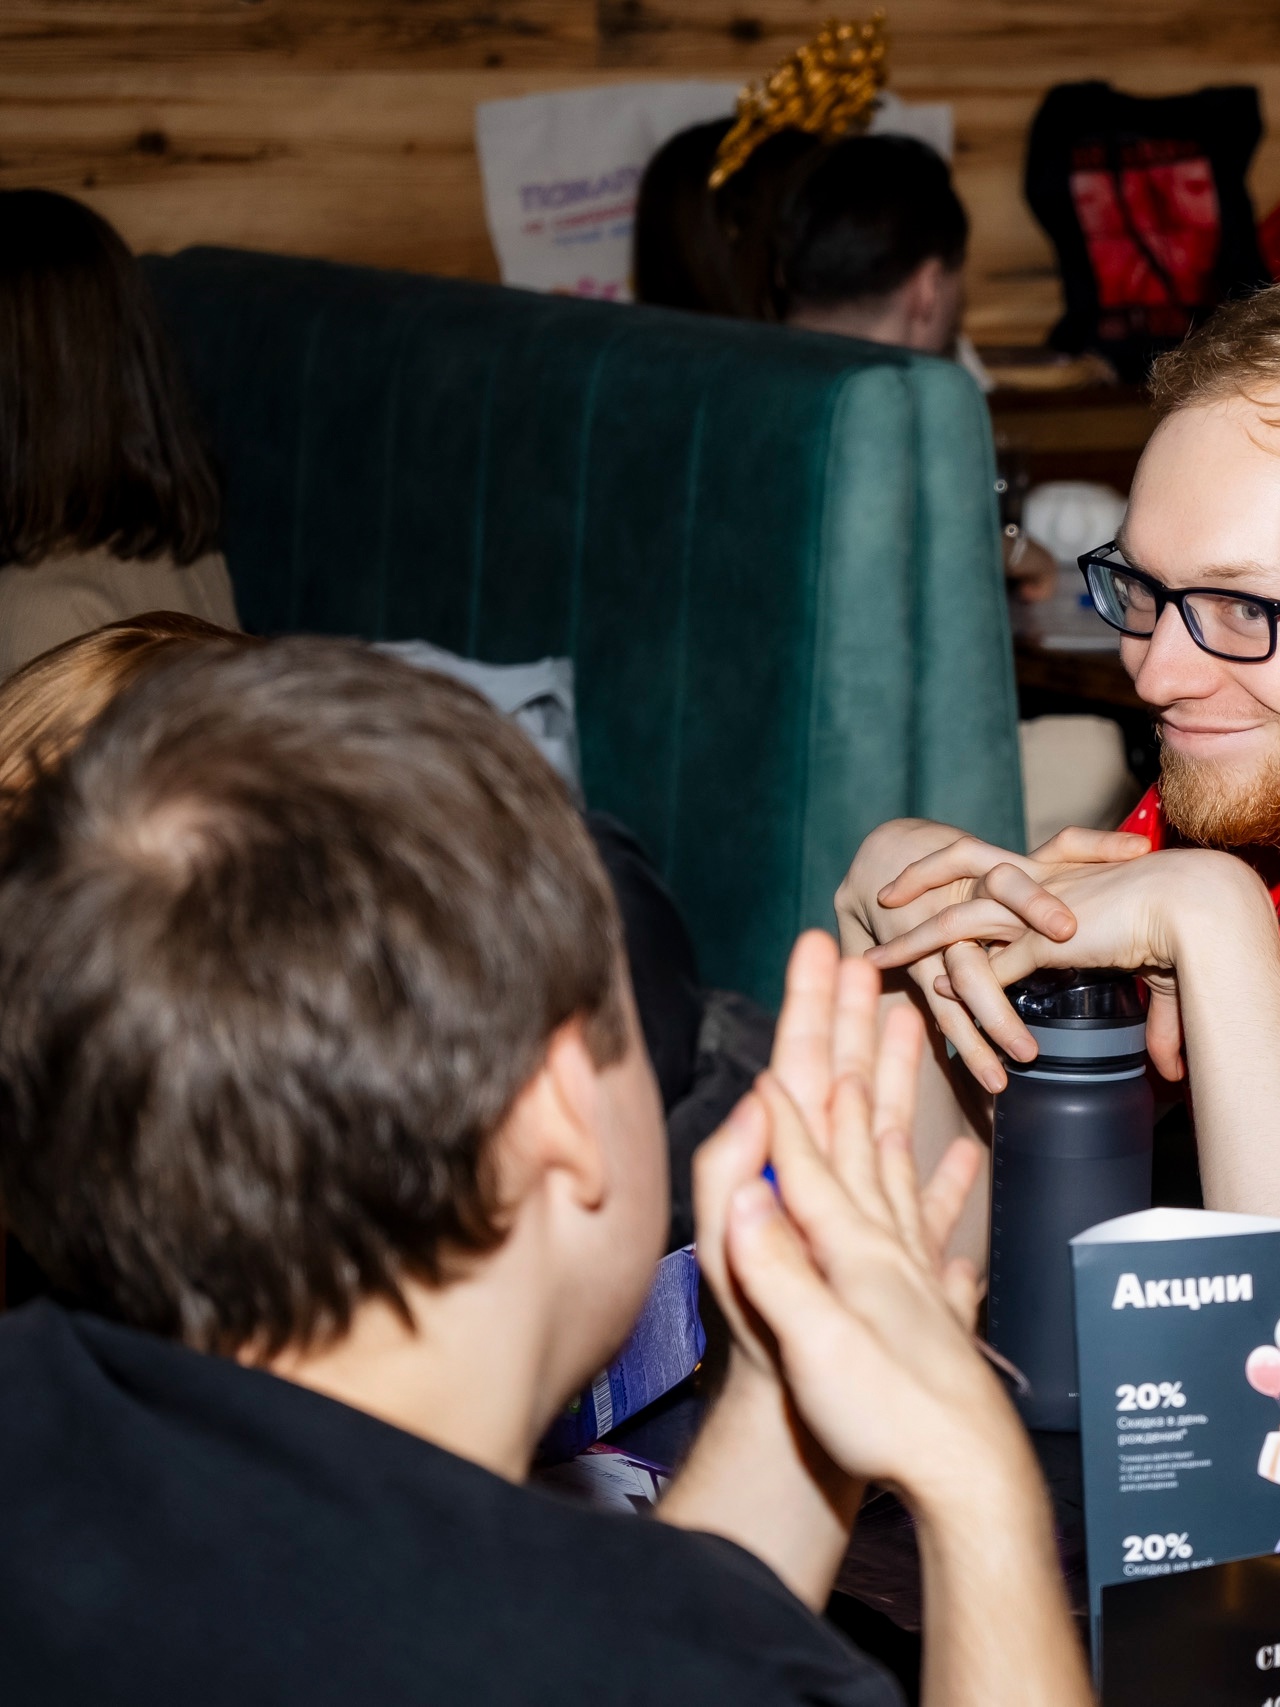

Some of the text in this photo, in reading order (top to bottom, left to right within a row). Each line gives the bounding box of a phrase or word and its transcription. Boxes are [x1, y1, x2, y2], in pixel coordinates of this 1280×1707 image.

[1112, 1273, 1253, 1310] Акции
[1115, 1381, 1187, 1411] 20%
[1117, 1416, 1165, 1430] Скидка
[1122, 1532, 1194, 1562] 20%
[1123, 1563, 1171, 1577] Скидка
